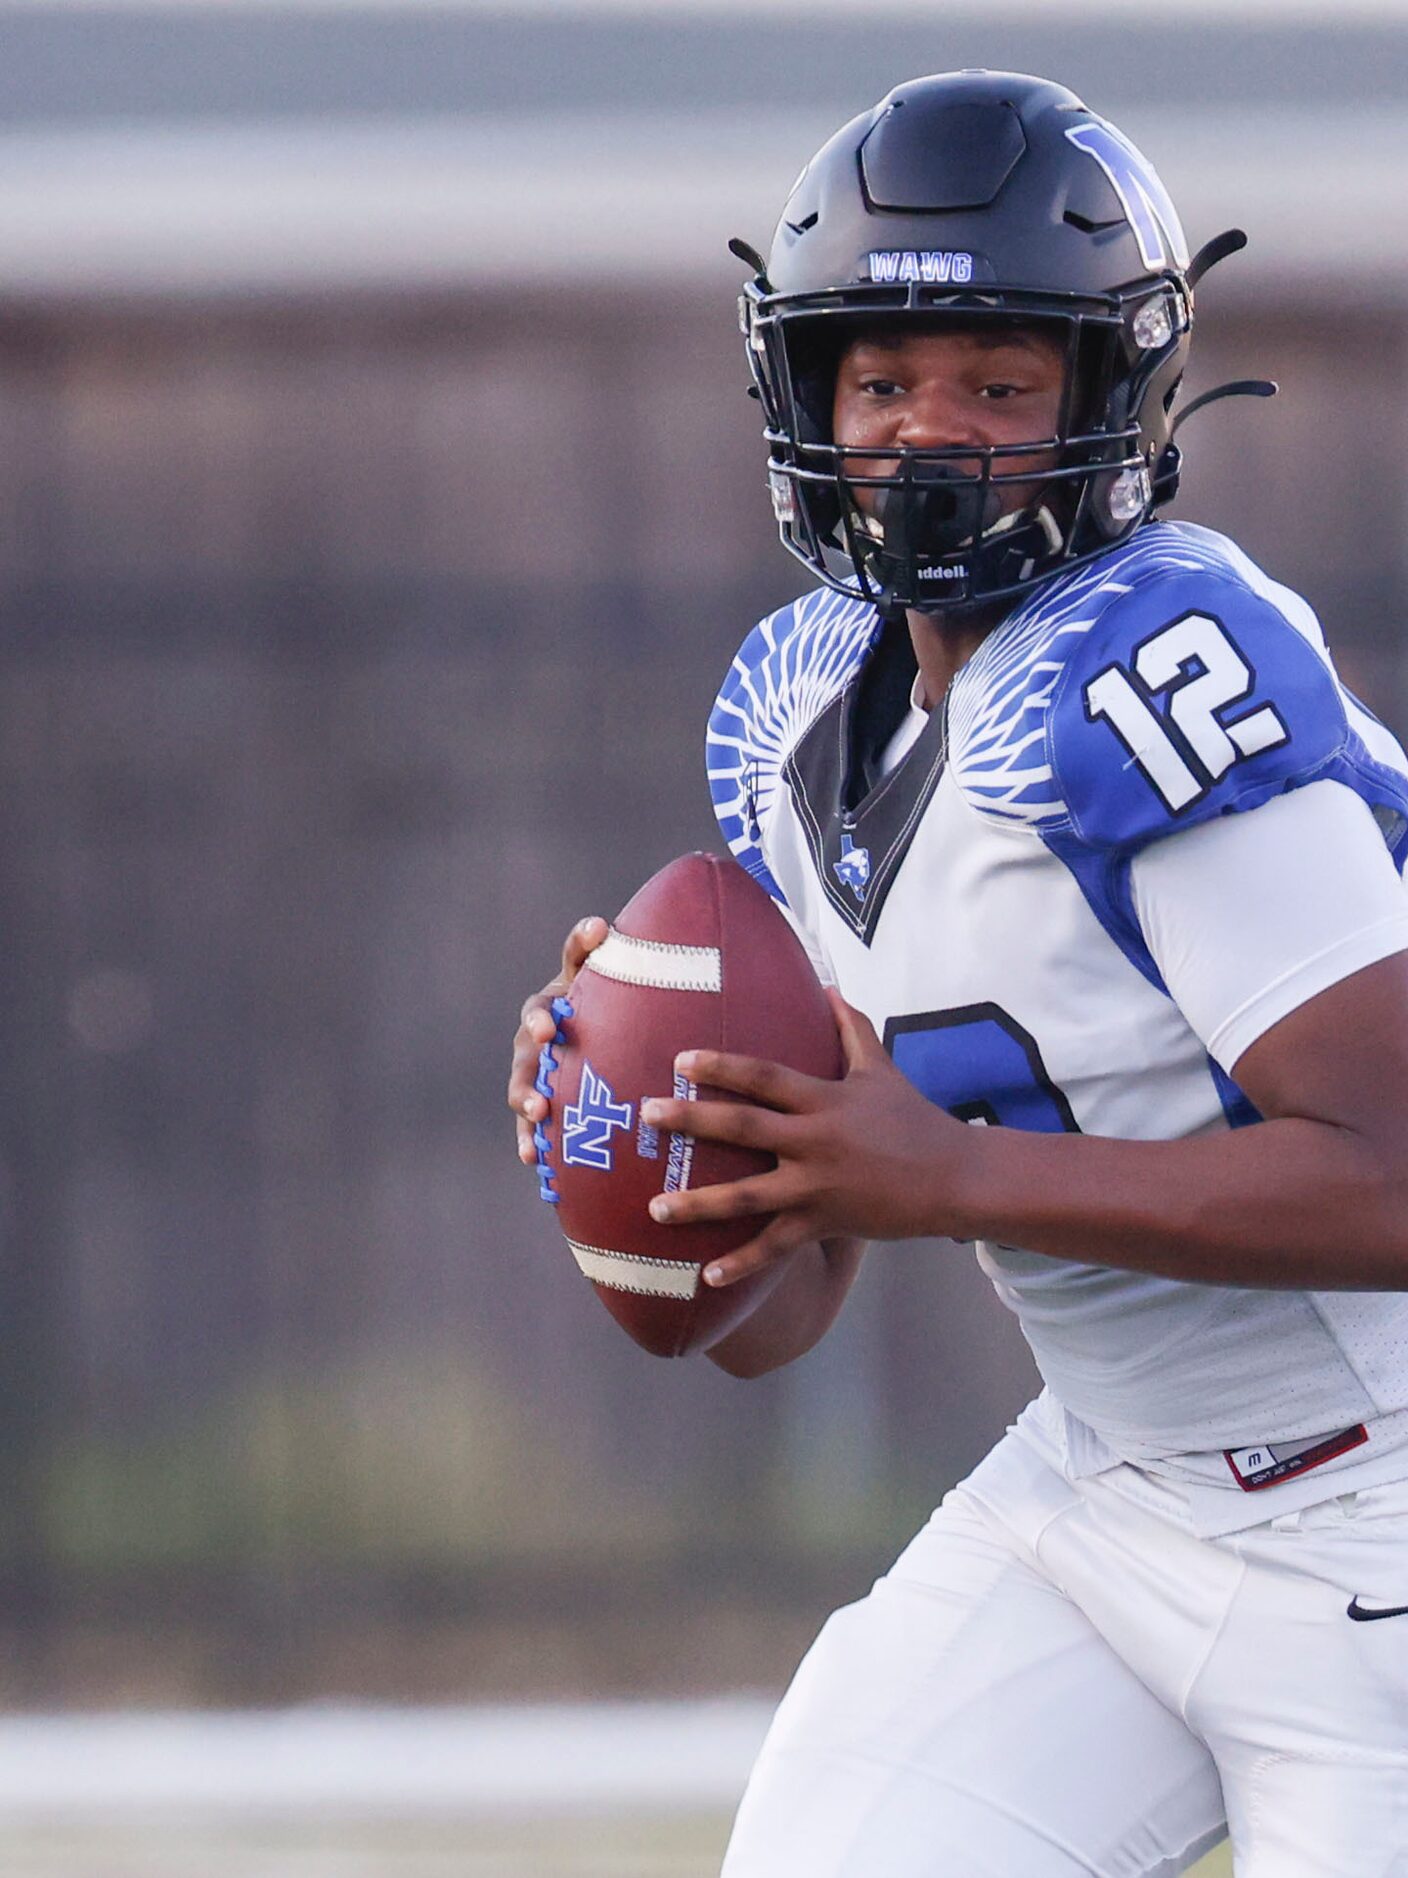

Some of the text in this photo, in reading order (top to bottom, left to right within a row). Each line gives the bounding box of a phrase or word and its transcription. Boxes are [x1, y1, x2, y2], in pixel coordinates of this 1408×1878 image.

[869, 251, 973, 283] WAWG
[917, 564, 966, 580] iddell
[1085, 610, 1291, 816] 12
[562, 1062, 632, 1169] NF
